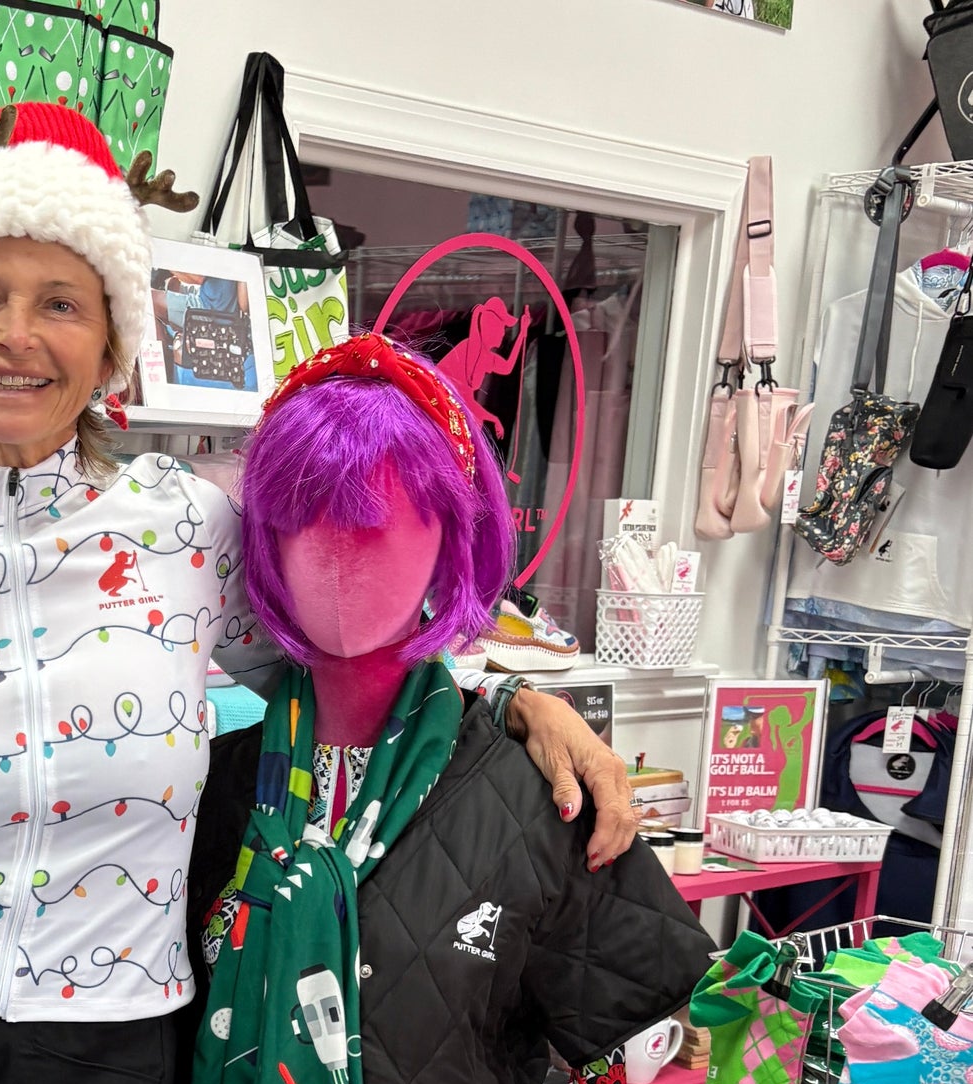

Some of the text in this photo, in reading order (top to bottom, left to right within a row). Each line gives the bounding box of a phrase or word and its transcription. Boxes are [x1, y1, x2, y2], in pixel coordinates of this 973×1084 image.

[269, 266, 342, 298] Jus
[267, 296, 345, 380] Gir
[99, 599, 136, 611] PUTTER
[711, 753, 765, 764] IT'S NOT A
[710, 765, 740, 775] GOLF
[708, 786, 778, 797] IT'S LIP BALM
[453, 941, 497, 961] PUTTER GIRL
